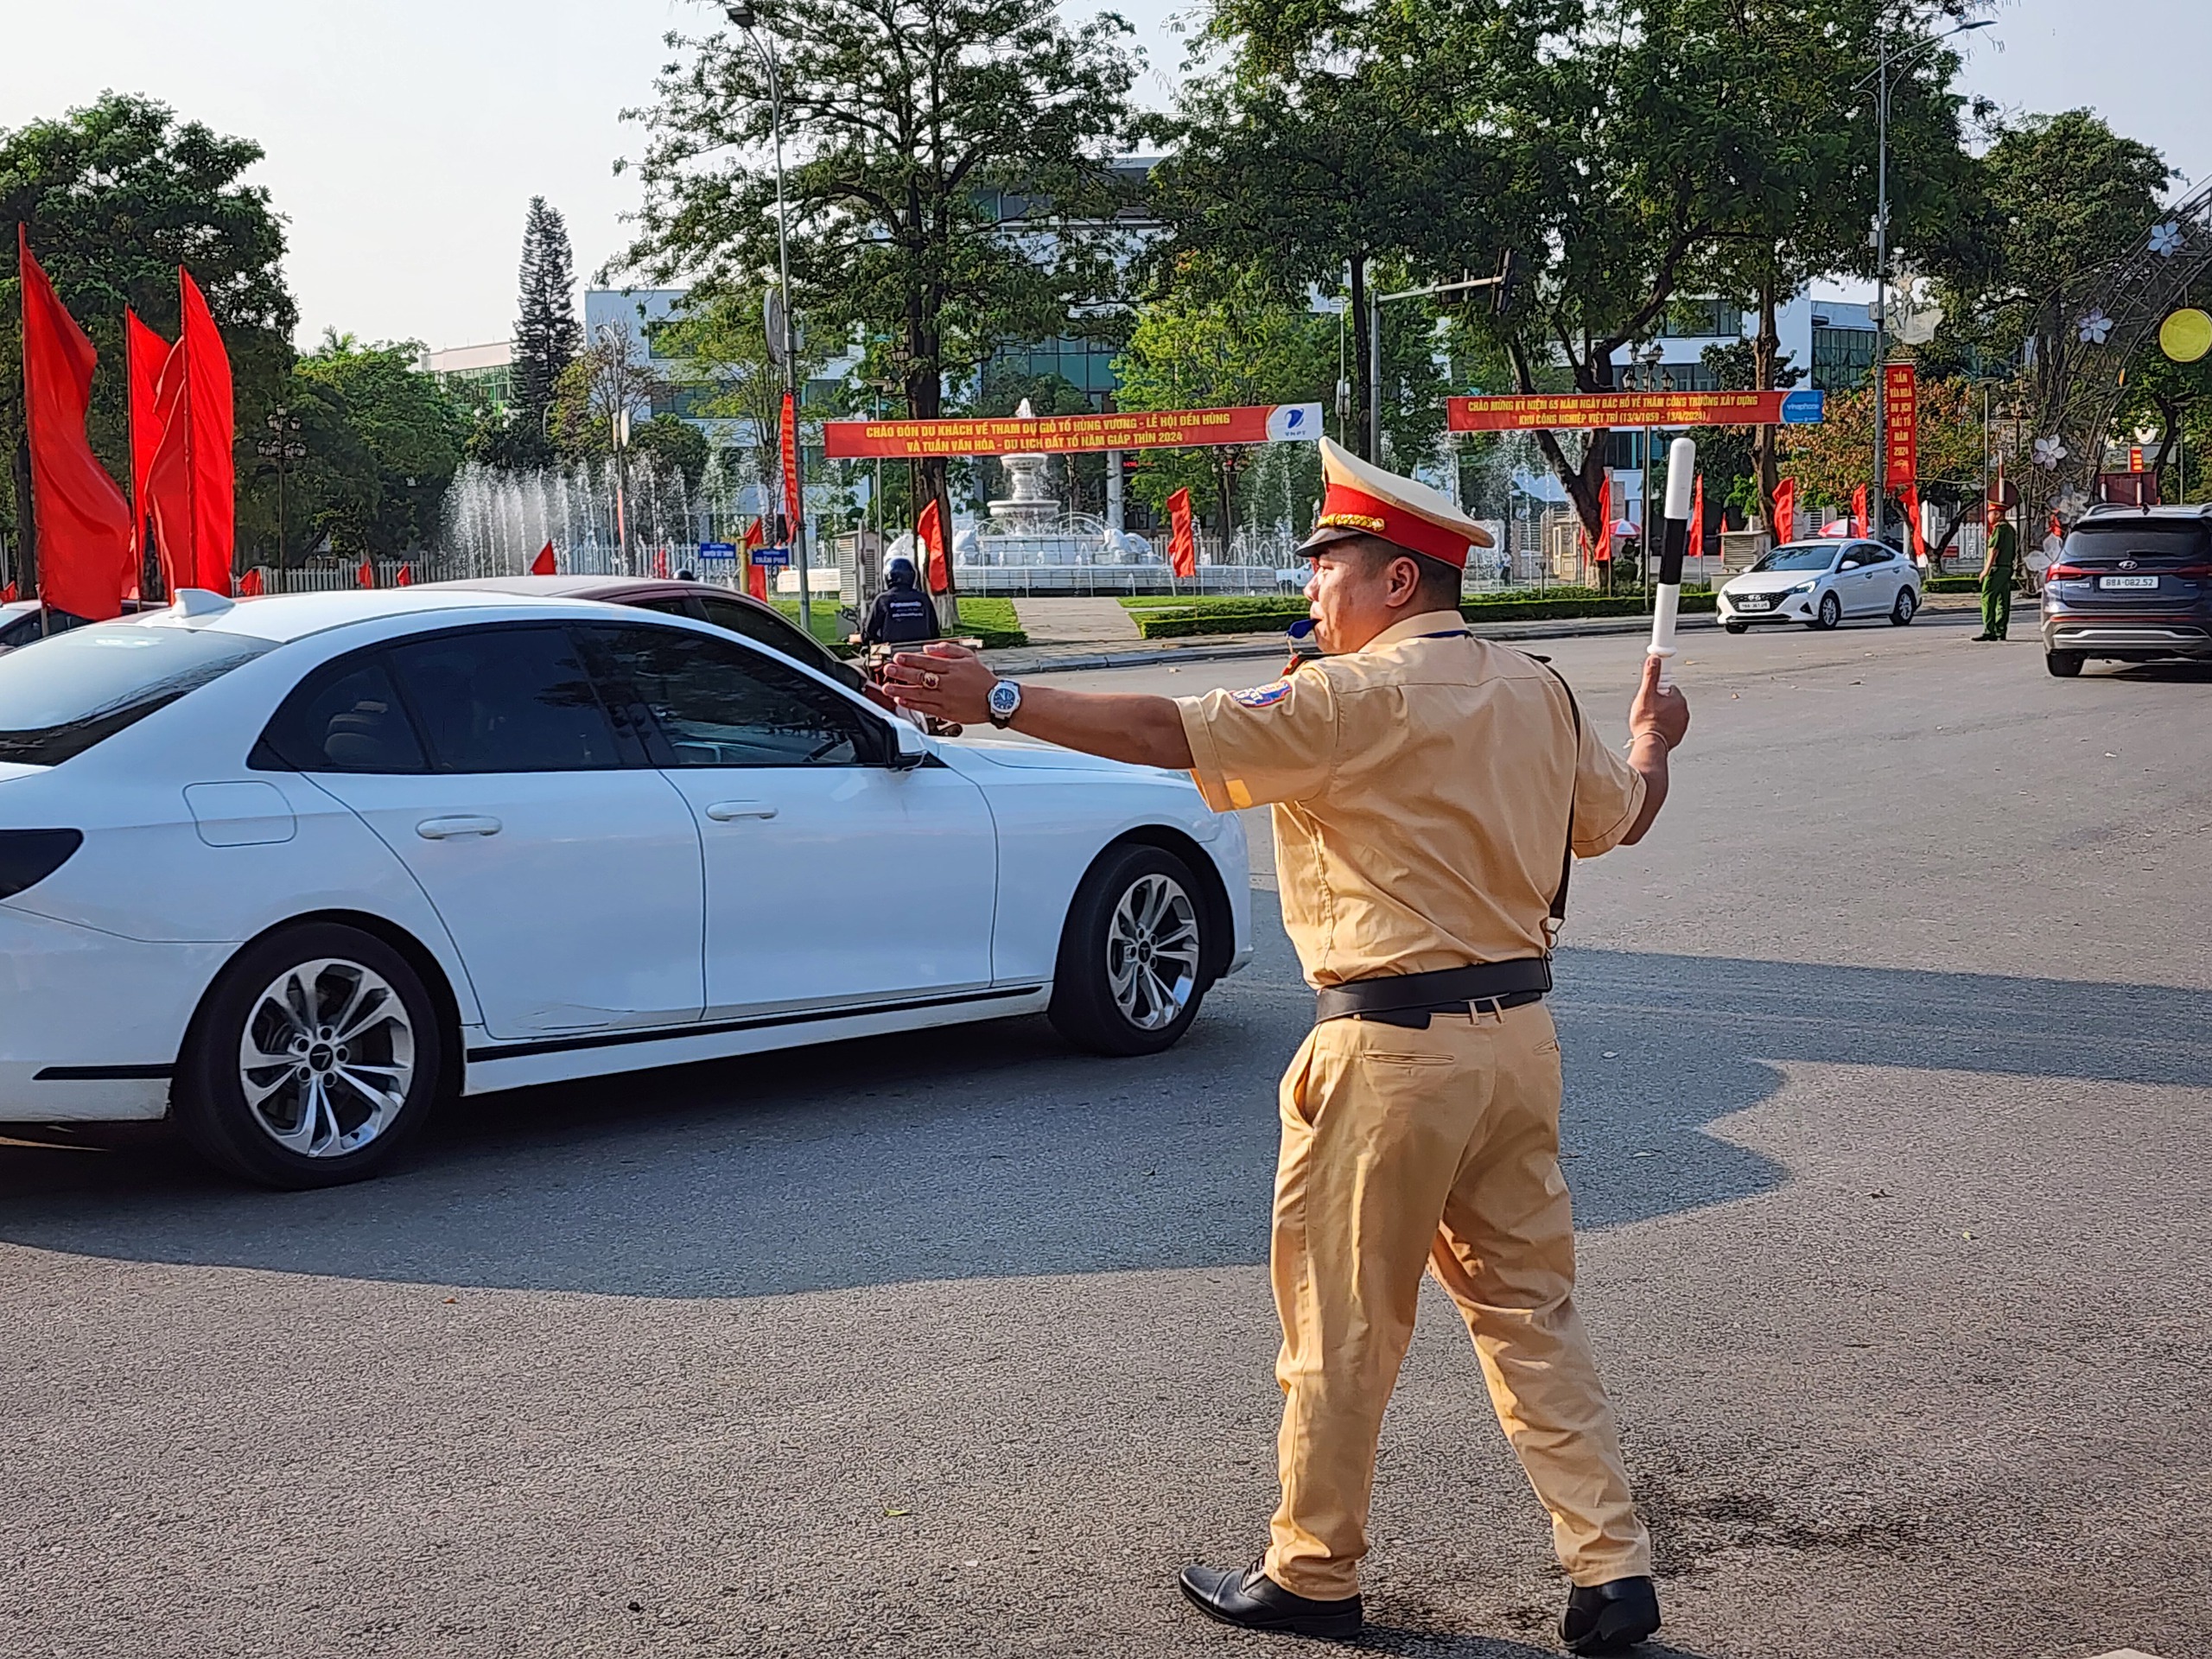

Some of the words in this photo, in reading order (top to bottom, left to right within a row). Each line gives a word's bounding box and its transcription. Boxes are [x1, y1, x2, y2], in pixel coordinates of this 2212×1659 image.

[1468, 399, 1488, 411] CHÀO
[1548, 399, 1558, 410] 65
[1580, 397, 1599, 409] NGÀY
[1666, 394, 1687, 407] CÔNG
[866, 423, 893, 437] CHÀO
[897, 423, 919, 437] ĐÓN
[922, 425, 935, 436] DU
[938, 423, 973, 436] KHÁCH
[976, 422, 988, 435] VỀ
[991, 423, 1020, 435] THAM
[1023, 422, 1038, 435] DỰ
[1073, 419, 1101, 432] HÙNG
[1103, 418, 1137, 430] VƯƠNG
[1147, 414, 1158, 428] LỄ
[1160, 414, 1178, 429] HỘI
[1179, 413, 1199, 426] ĐỀN
[1203, 413, 1230, 425] HÙNG
[1519, 415, 1534, 425] KHU
[1536, 413, 1556, 424] CÔNG
[907, 441, 920, 452] VÀ
[923, 437, 949, 452] TUẦN
[951, 439, 972, 451] VĂN
[975, 438, 995, 450] HÓA
[1004, 439, 1018, 449] DU
[1020, 438, 1042, 451] LỊCH
[1044, 434, 1065, 448] ĐẤT
[1082, 434, 1104, 447] NĂM
[1108, 432, 1130, 445] GIÁP
[1134, 432, 1156, 444] THÌN
[1158, 432, 1182, 442] 2024
